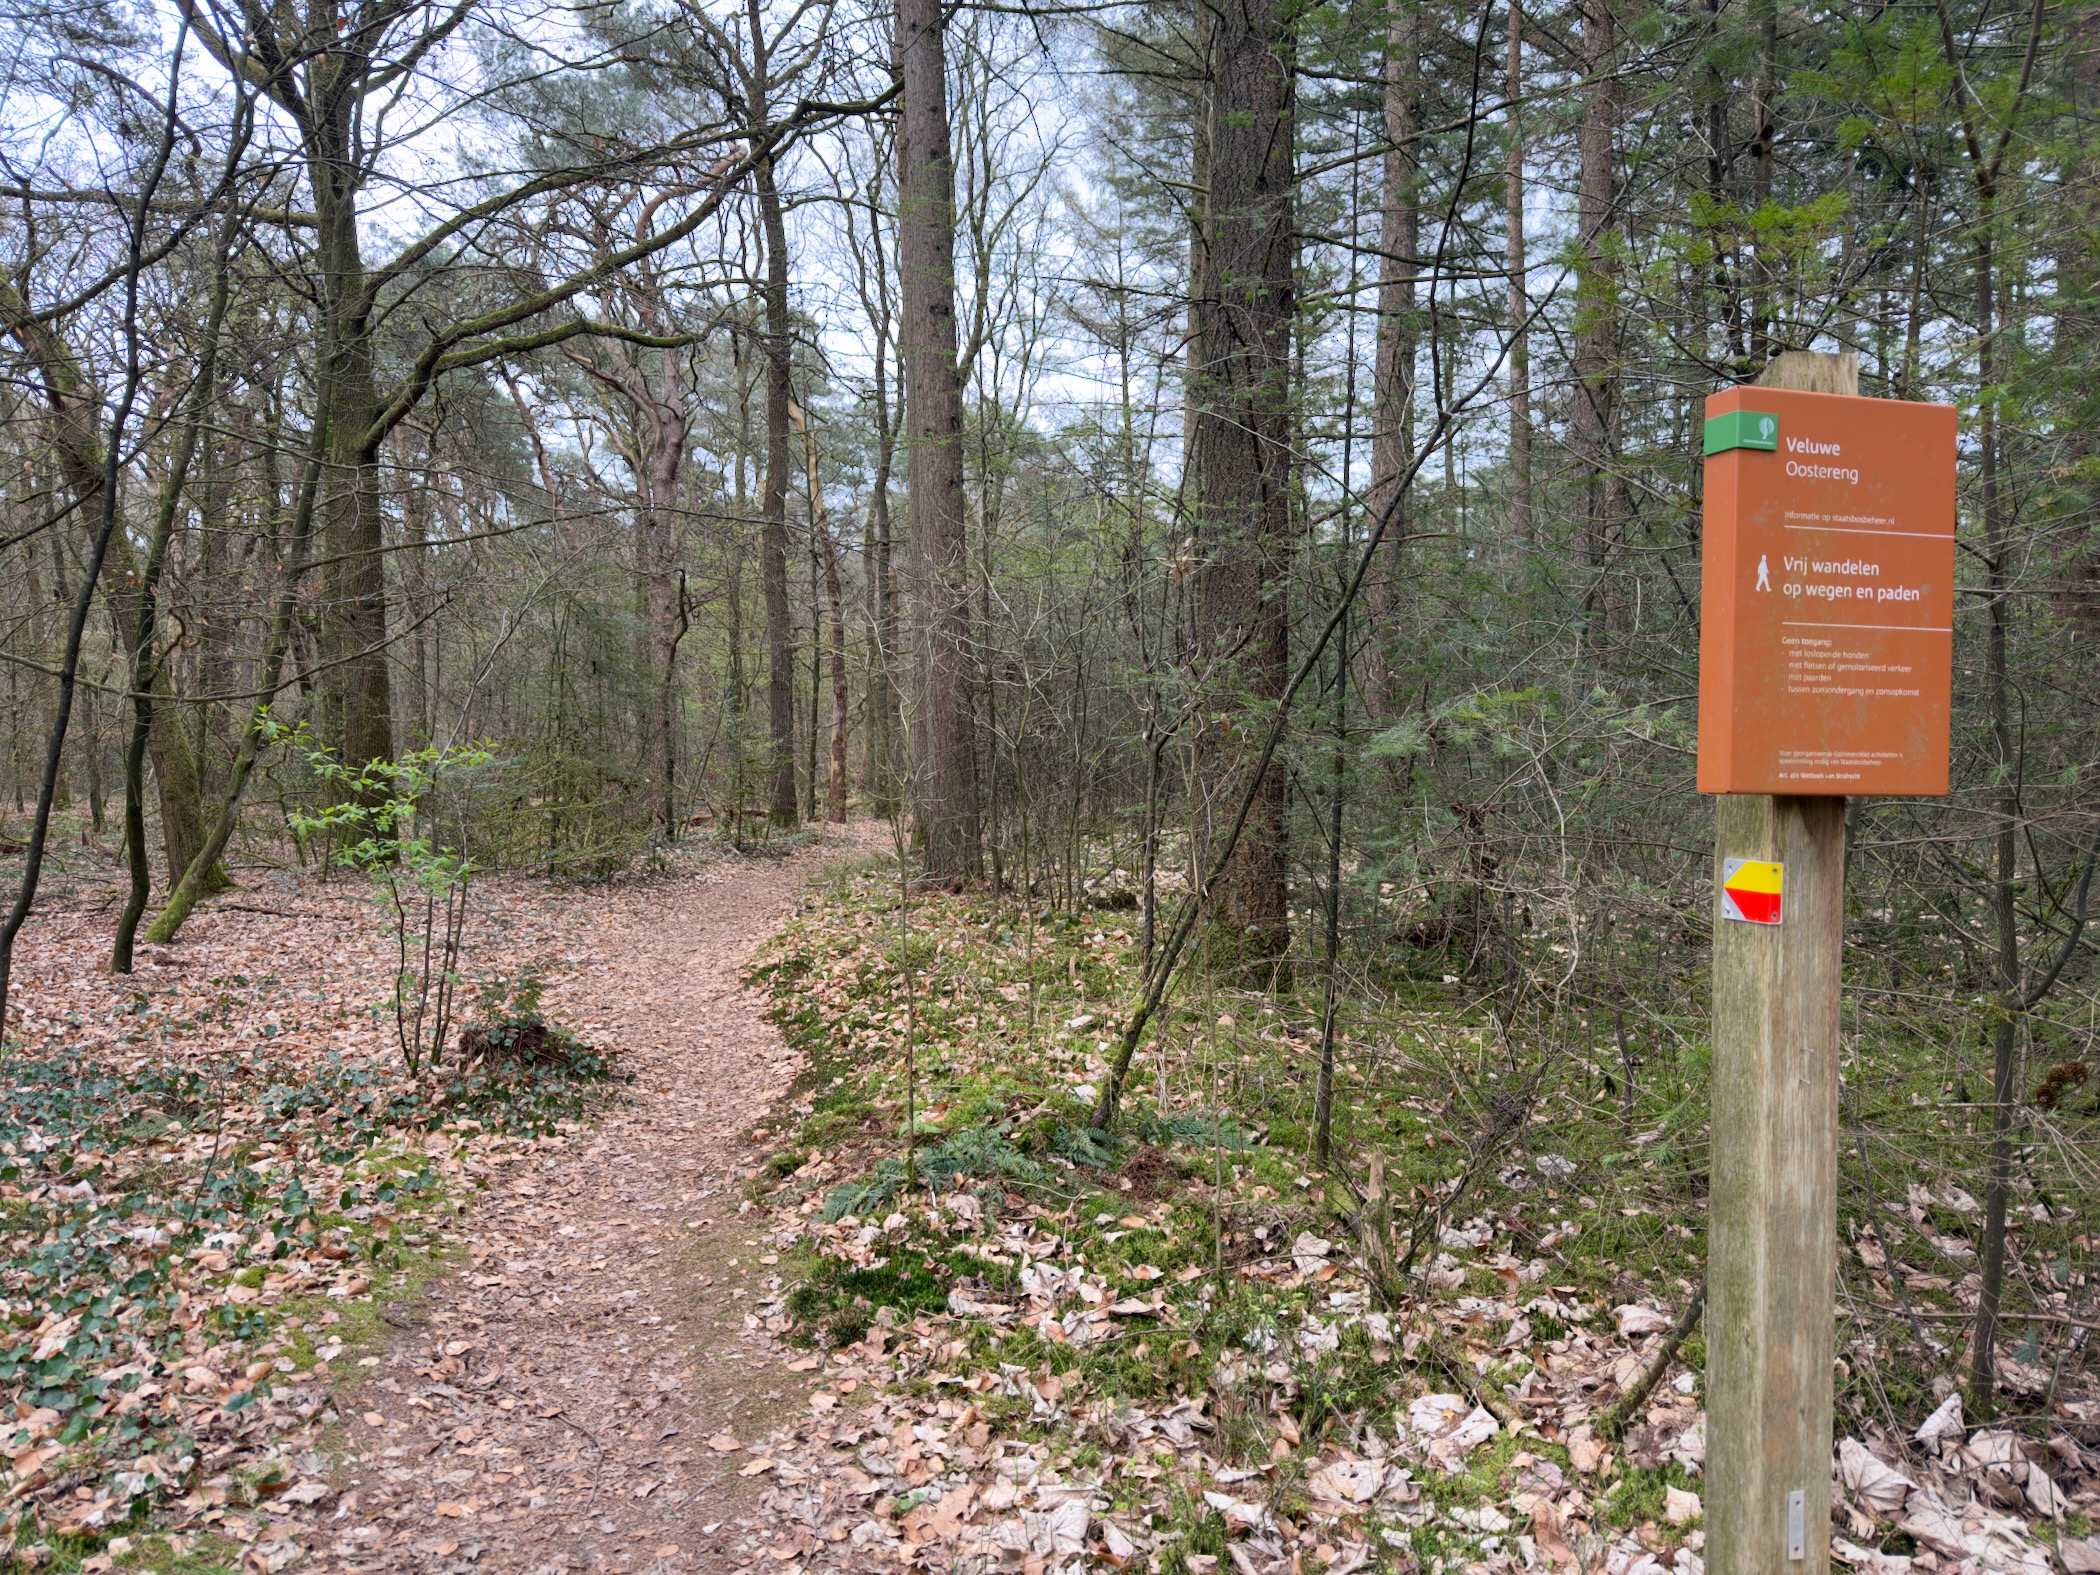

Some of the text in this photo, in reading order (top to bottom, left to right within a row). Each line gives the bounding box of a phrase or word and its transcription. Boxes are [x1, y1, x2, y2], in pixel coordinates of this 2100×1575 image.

[1786, 437, 1841, 456] Veluwe
[1786, 460, 1859, 485] Oostereng
[1821, 514, 1831, 522] op
[1832, 514, 1895, 525] staatsbosbeheer.nl
[1784, 556, 1879, 576] Vrij wandelen
[1783, 583, 1920, 603] op wegen en paden
[1782, 636, 1833, 647] Geen toegang:
[1789, 649, 1869, 659] met loslopende honden
[1804, 662, 1827, 670] fietsen
[1828, 662, 1836, 670] of
[1837, 663, 1886, 672] gemotoriseerd
[1887, 664, 1912, 673] verkeer
[1803, 674, 1832, 682] paarden
[1788, 685, 1810, 693] tussen
[1812, 686, 1864, 696] zonsondergang
[1876, 688, 1920, 697] zonsopkomst
